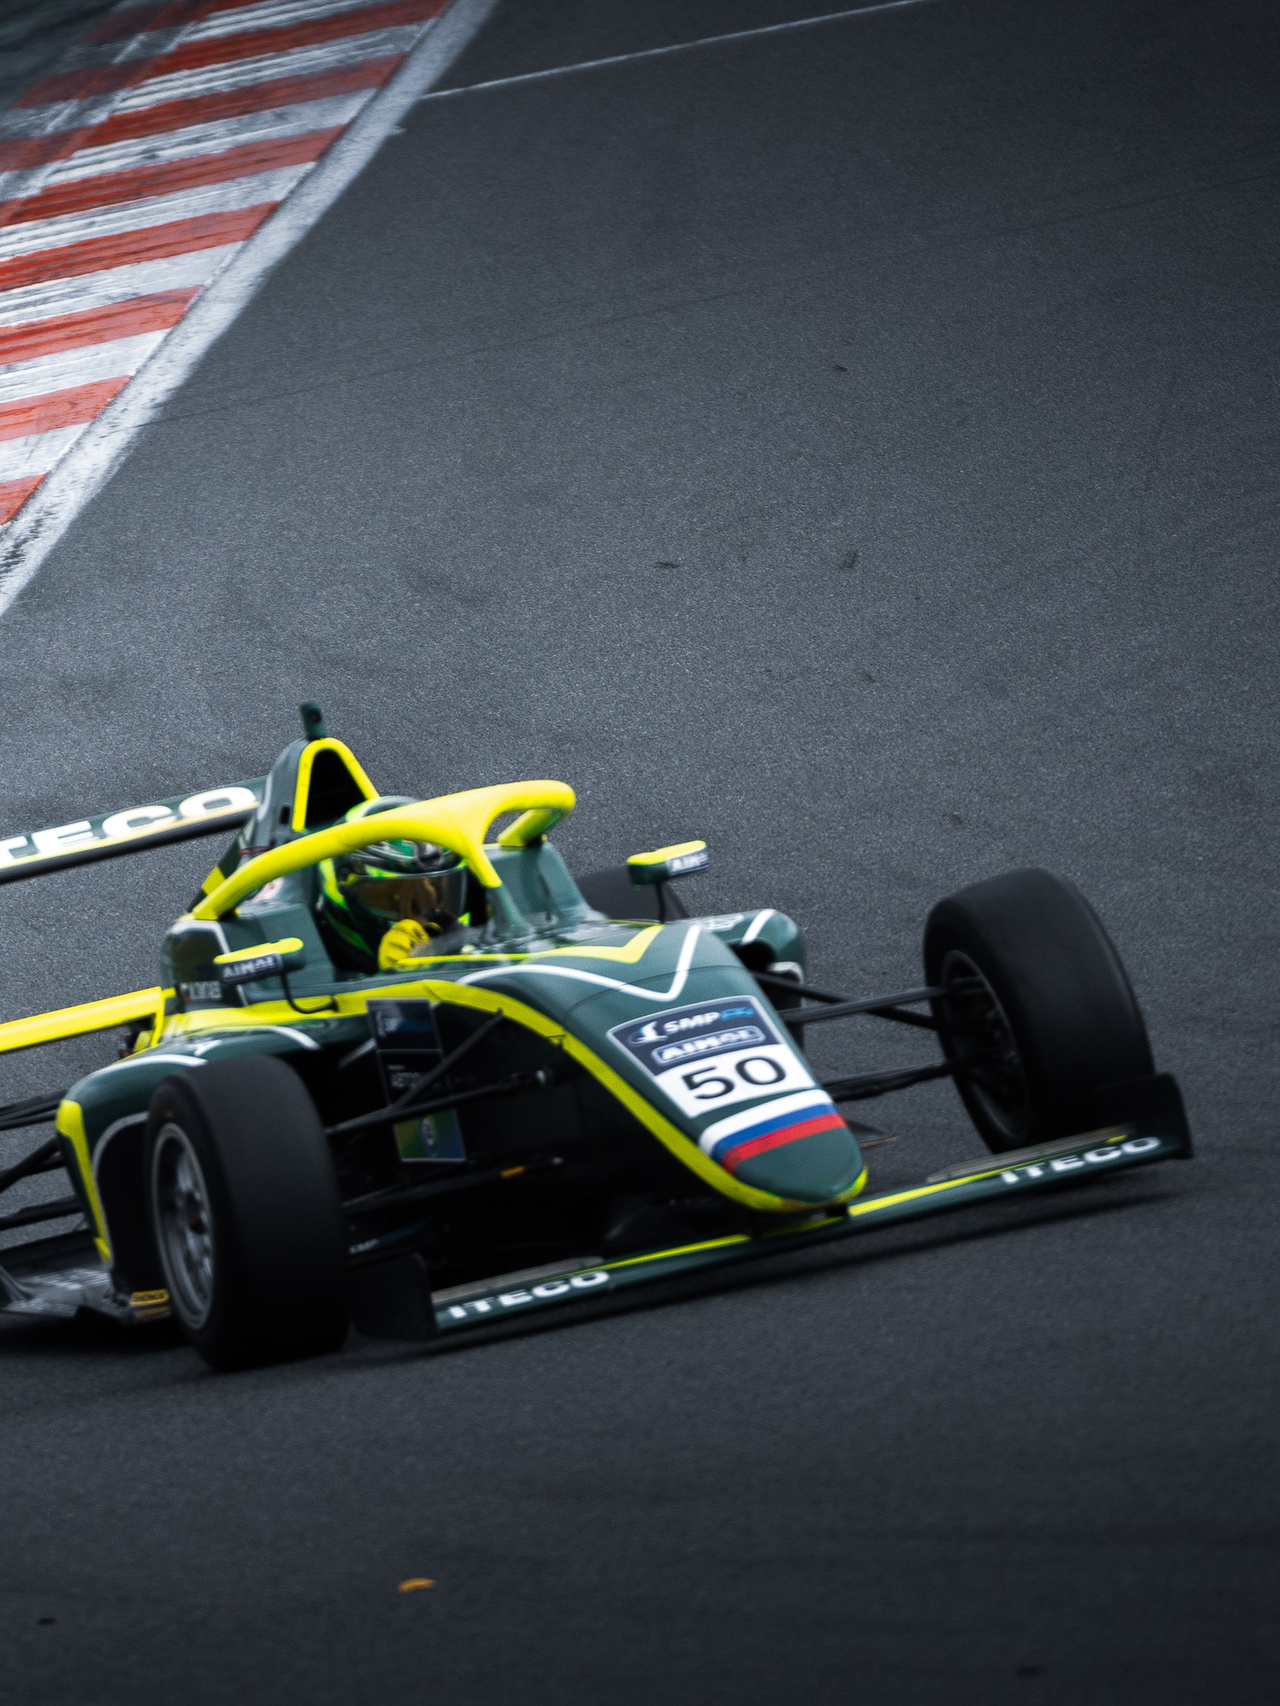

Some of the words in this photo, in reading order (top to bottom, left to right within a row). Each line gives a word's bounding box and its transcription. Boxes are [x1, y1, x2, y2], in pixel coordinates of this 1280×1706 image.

[663, 1010, 721, 1035] SMP
[681, 1055, 787, 1100] 50
[1000, 1136, 1163, 1186] ITECO
[448, 1270, 611, 1320] ITECO
